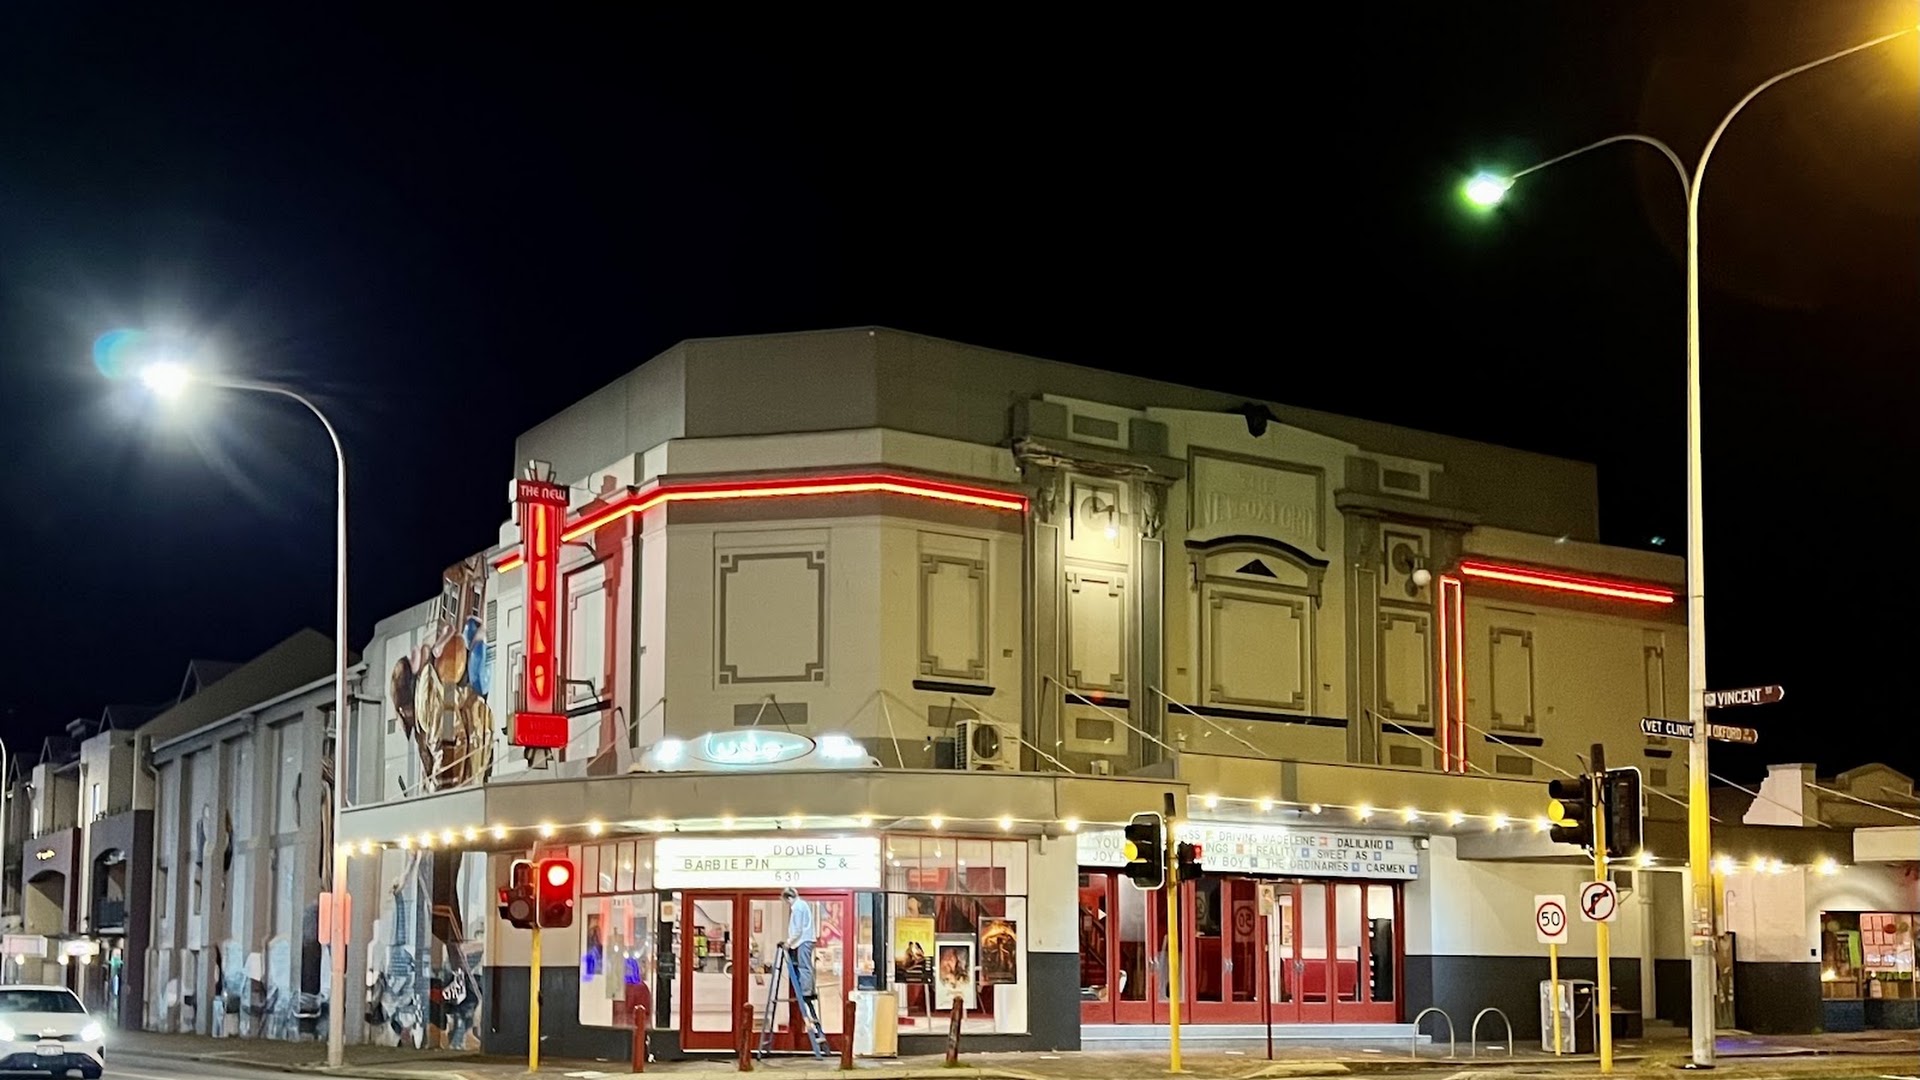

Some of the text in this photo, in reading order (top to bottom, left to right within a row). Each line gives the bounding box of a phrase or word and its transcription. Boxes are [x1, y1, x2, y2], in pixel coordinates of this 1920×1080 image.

[1717, 689, 1762, 706] VINCENT
[1645, 720, 1693, 737] VET CLINIC
[1712, 724, 1742, 740] OXFORD
[774, 844, 833, 856] DOUBLE
[1096, 836, 1120, 849] YOU
[1093, 851, 1114, 862] JOY
[1205, 843, 1368, 860] INGS REALITY SWEET AS
[684, 857, 848, 870] BARBIE PIN S &
[1222, 857, 1245, 868] BOY
[1266, 859, 1284, 870] THE
[1290, 859, 1349, 872] ORDINARIES
[1366, 863, 1406, 873] CARMEN
[774, 871, 800, 882] 630
[1541, 911, 1560, 927] 50
